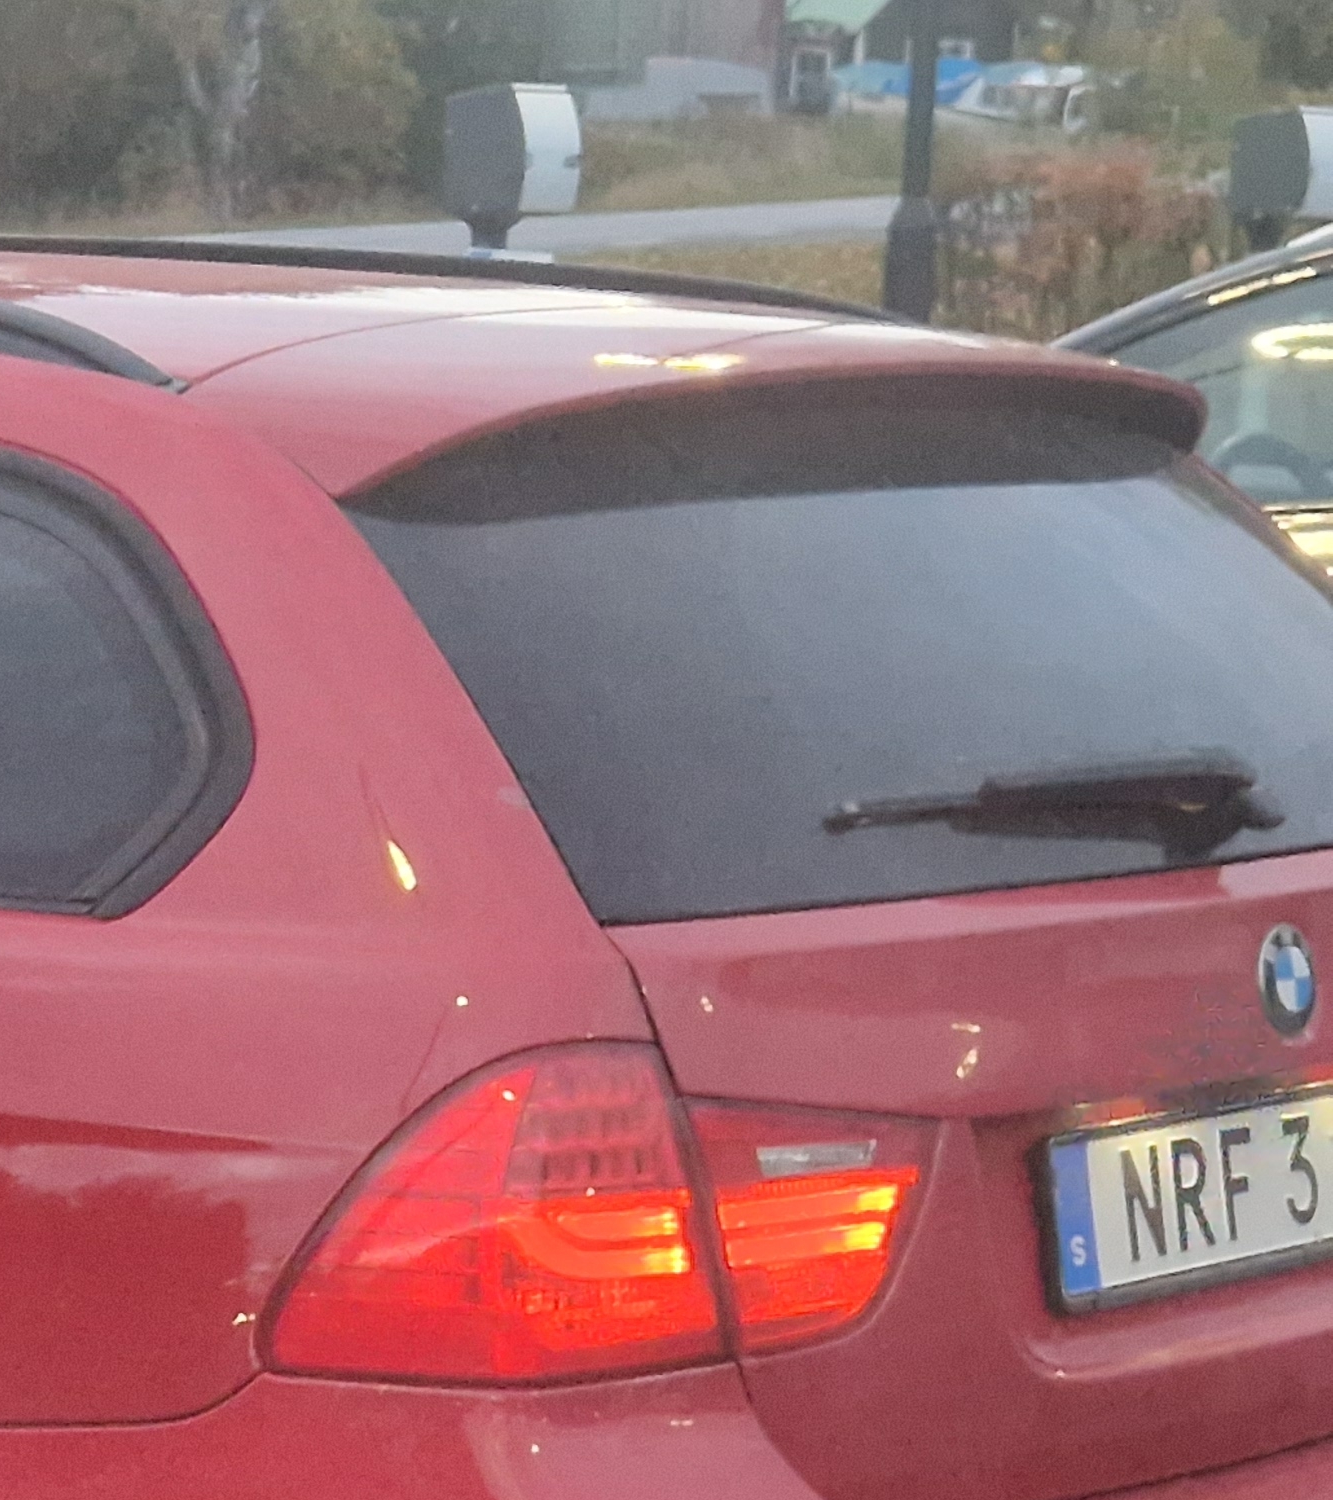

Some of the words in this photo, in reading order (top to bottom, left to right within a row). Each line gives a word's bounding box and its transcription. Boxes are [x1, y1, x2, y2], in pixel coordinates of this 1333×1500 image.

[1119, 1126, 1251, 1262] NRF
[1280, 1115, 1319, 1224] 3
[1070, 1235, 1087, 1266] S
